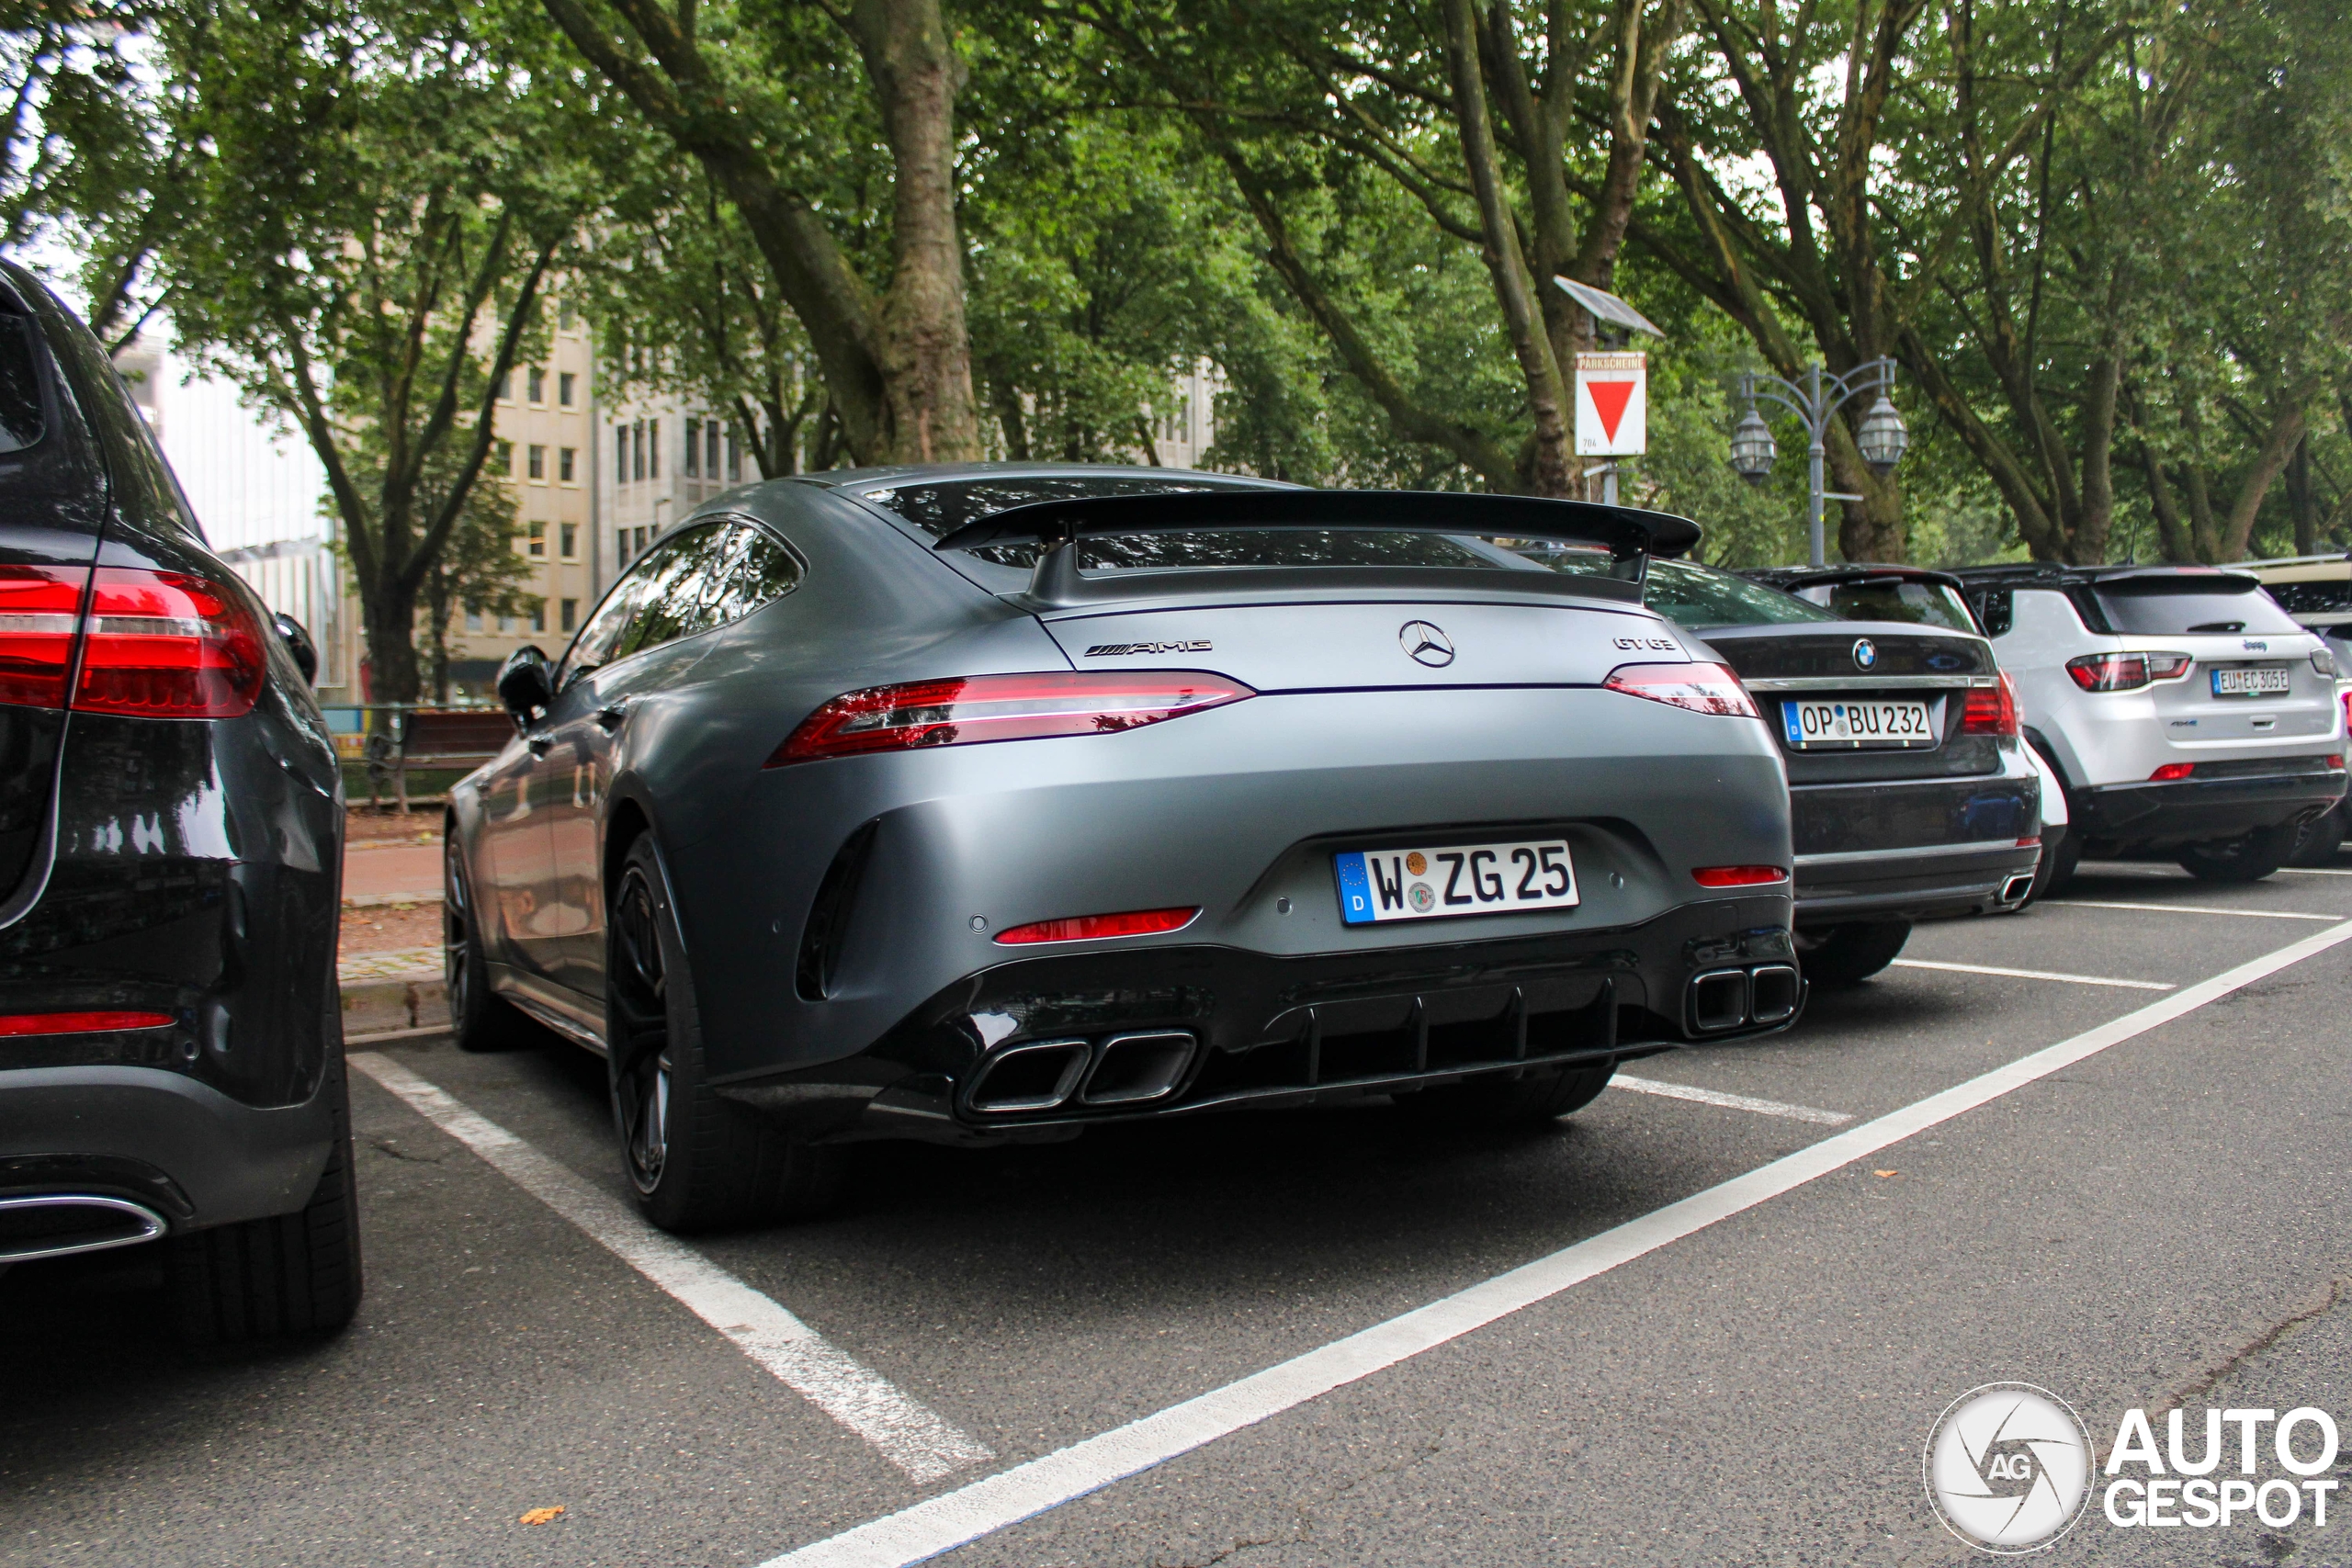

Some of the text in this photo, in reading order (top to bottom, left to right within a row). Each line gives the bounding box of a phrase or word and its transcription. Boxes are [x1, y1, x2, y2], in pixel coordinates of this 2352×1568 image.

[1579, 357, 1644, 369] PARKSCHEINE
[1126, 639, 1213, 654] AMG
[1612, 637, 1677, 650] GT 63
[2221, 672, 2236, 689] EU
[2244, 671, 2257, 689] EC
[1803, 706, 1832, 734] OP
[1848, 706, 1880, 734] BU
[1883, 706, 1927, 734] 232
[1352, 896, 1364, 911] D
[1371, 856, 1404, 910] W
[1436, 850, 1505, 906] ZG
[1511, 846, 1570, 899] 25
